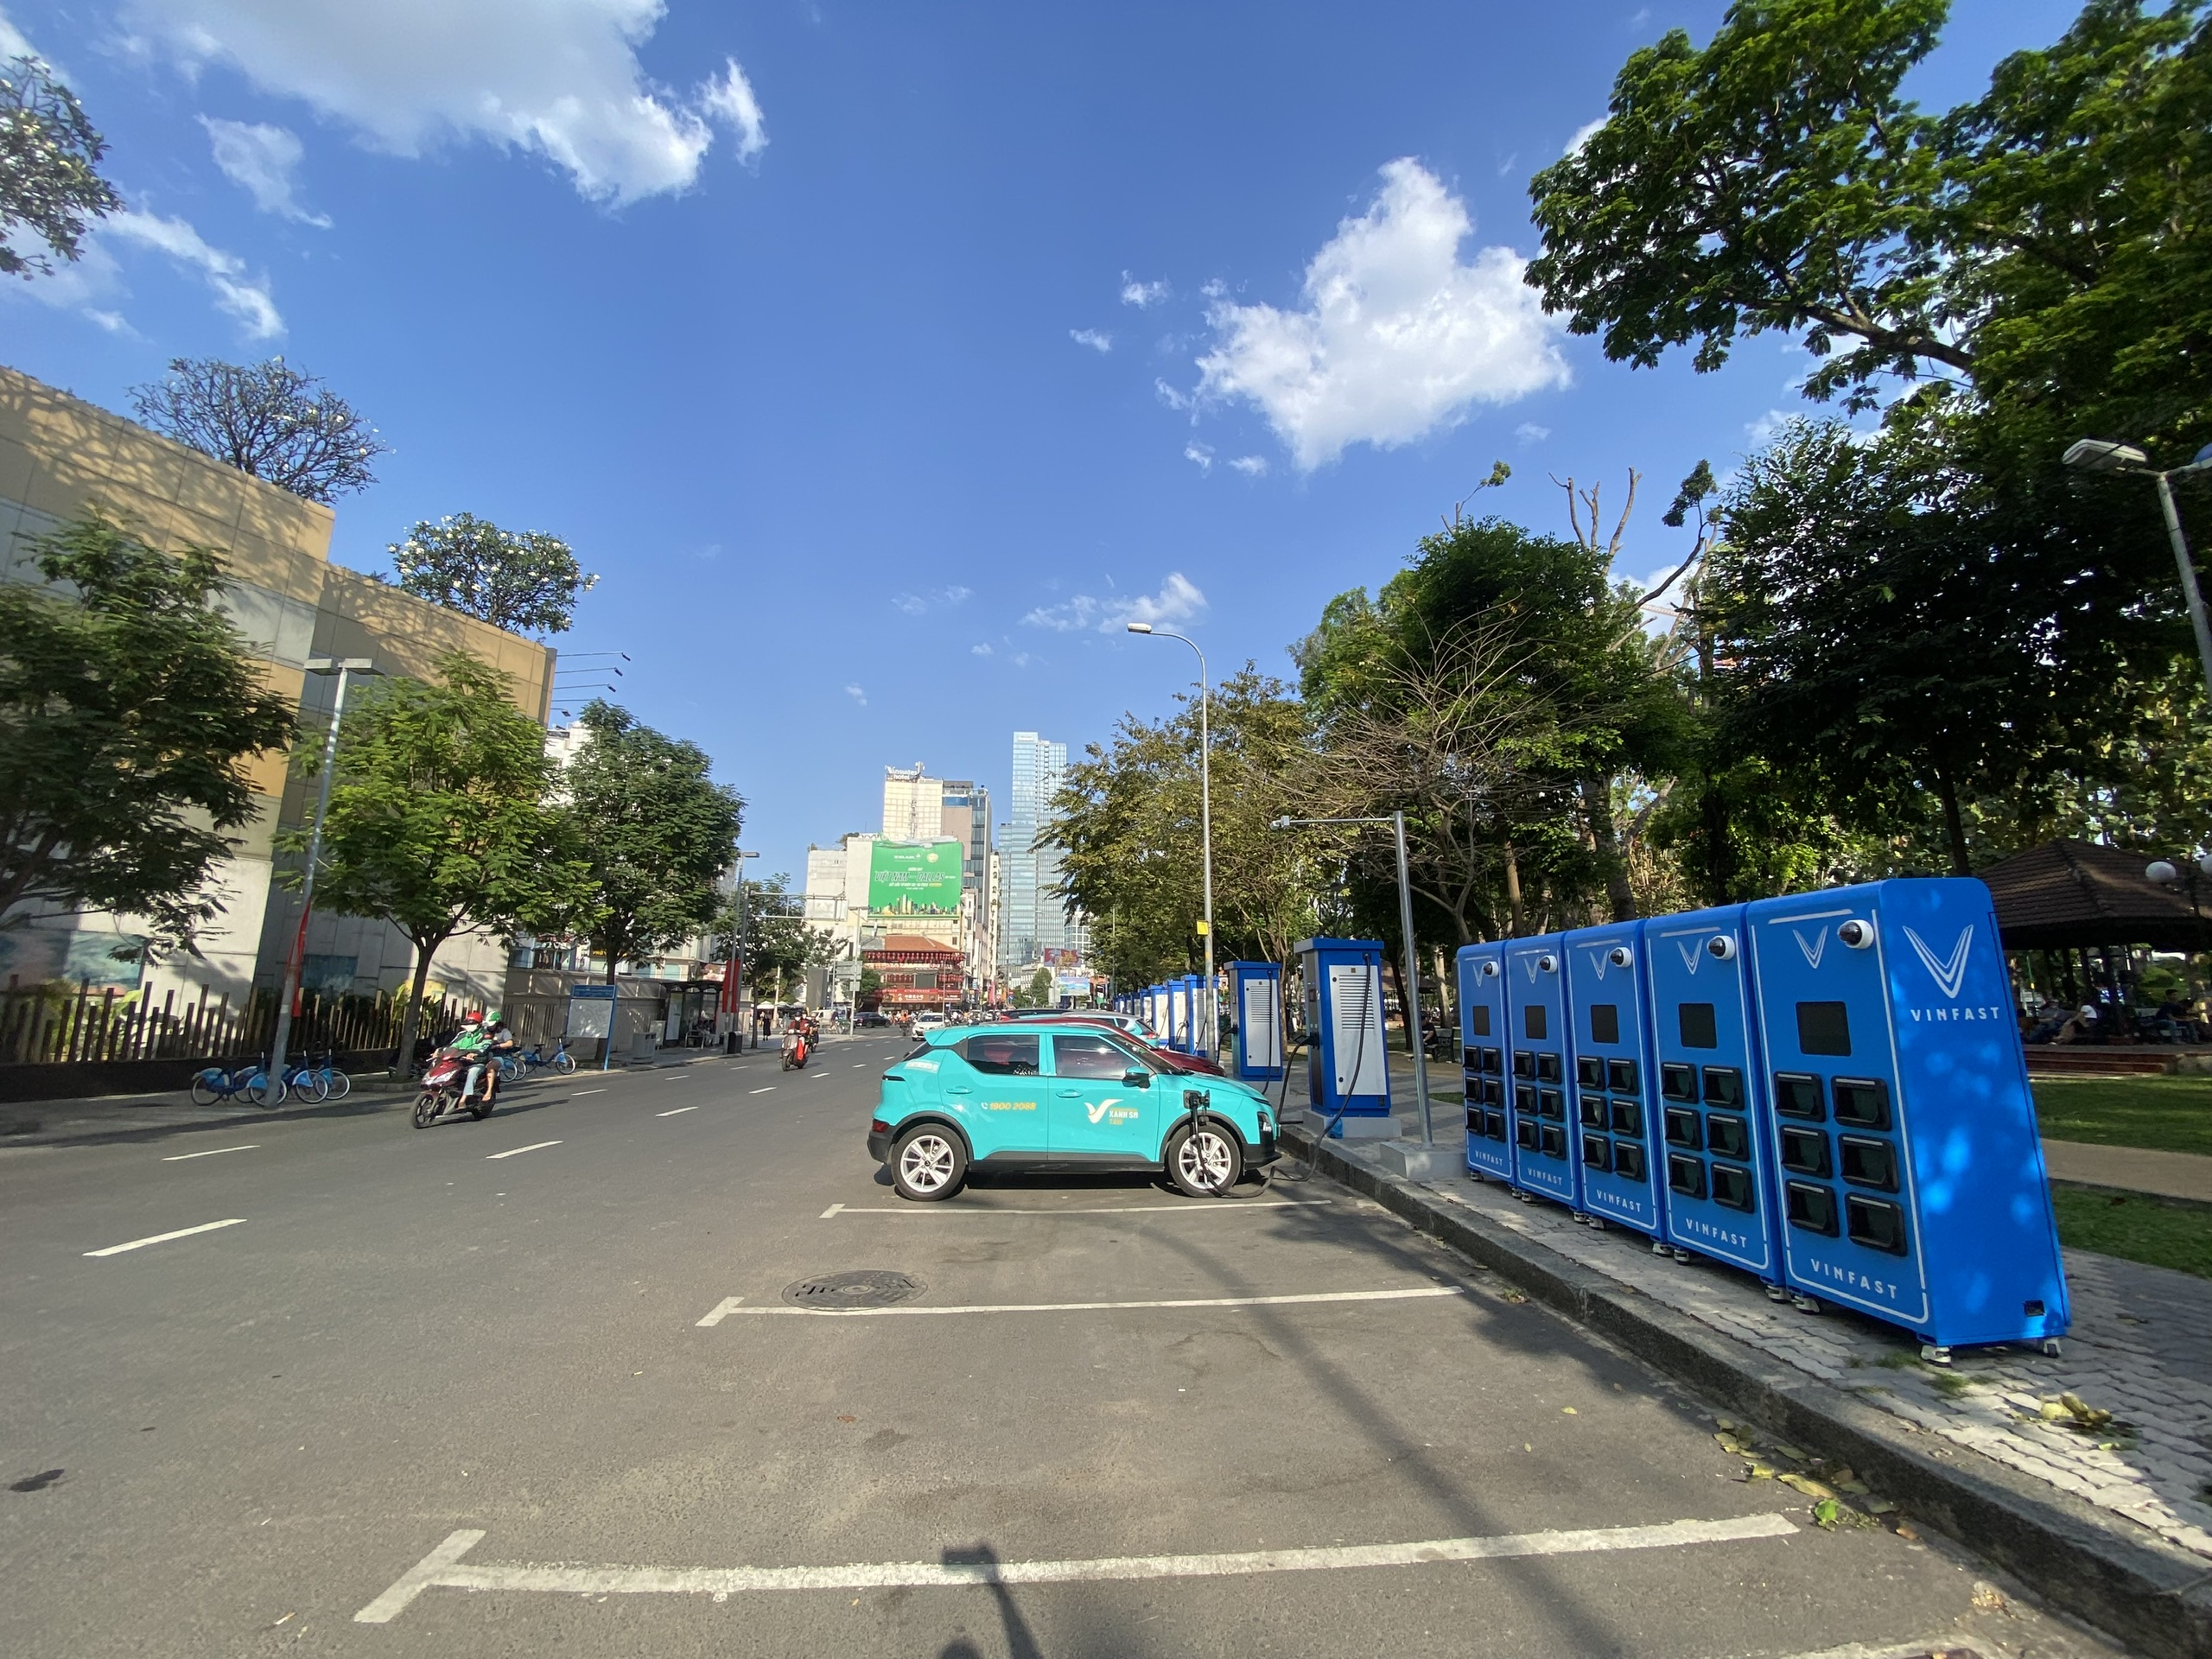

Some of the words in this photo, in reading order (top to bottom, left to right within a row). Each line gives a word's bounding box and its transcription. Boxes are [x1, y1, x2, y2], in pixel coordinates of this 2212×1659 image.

[917, 871, 945, 881] DALLAS
[1910, 1007, 1999, 1021] VINFAST
[1475, 1150, 1503, 1166] VINFAST
[1528, 1167, 1562, 1185] VINFAST
[1596, 1189, 1641, 1212] VINFAST
[1686, 1218, 1747, 1248] VINFAST
[1811, 1258, 1897, 1299] VINFAST
